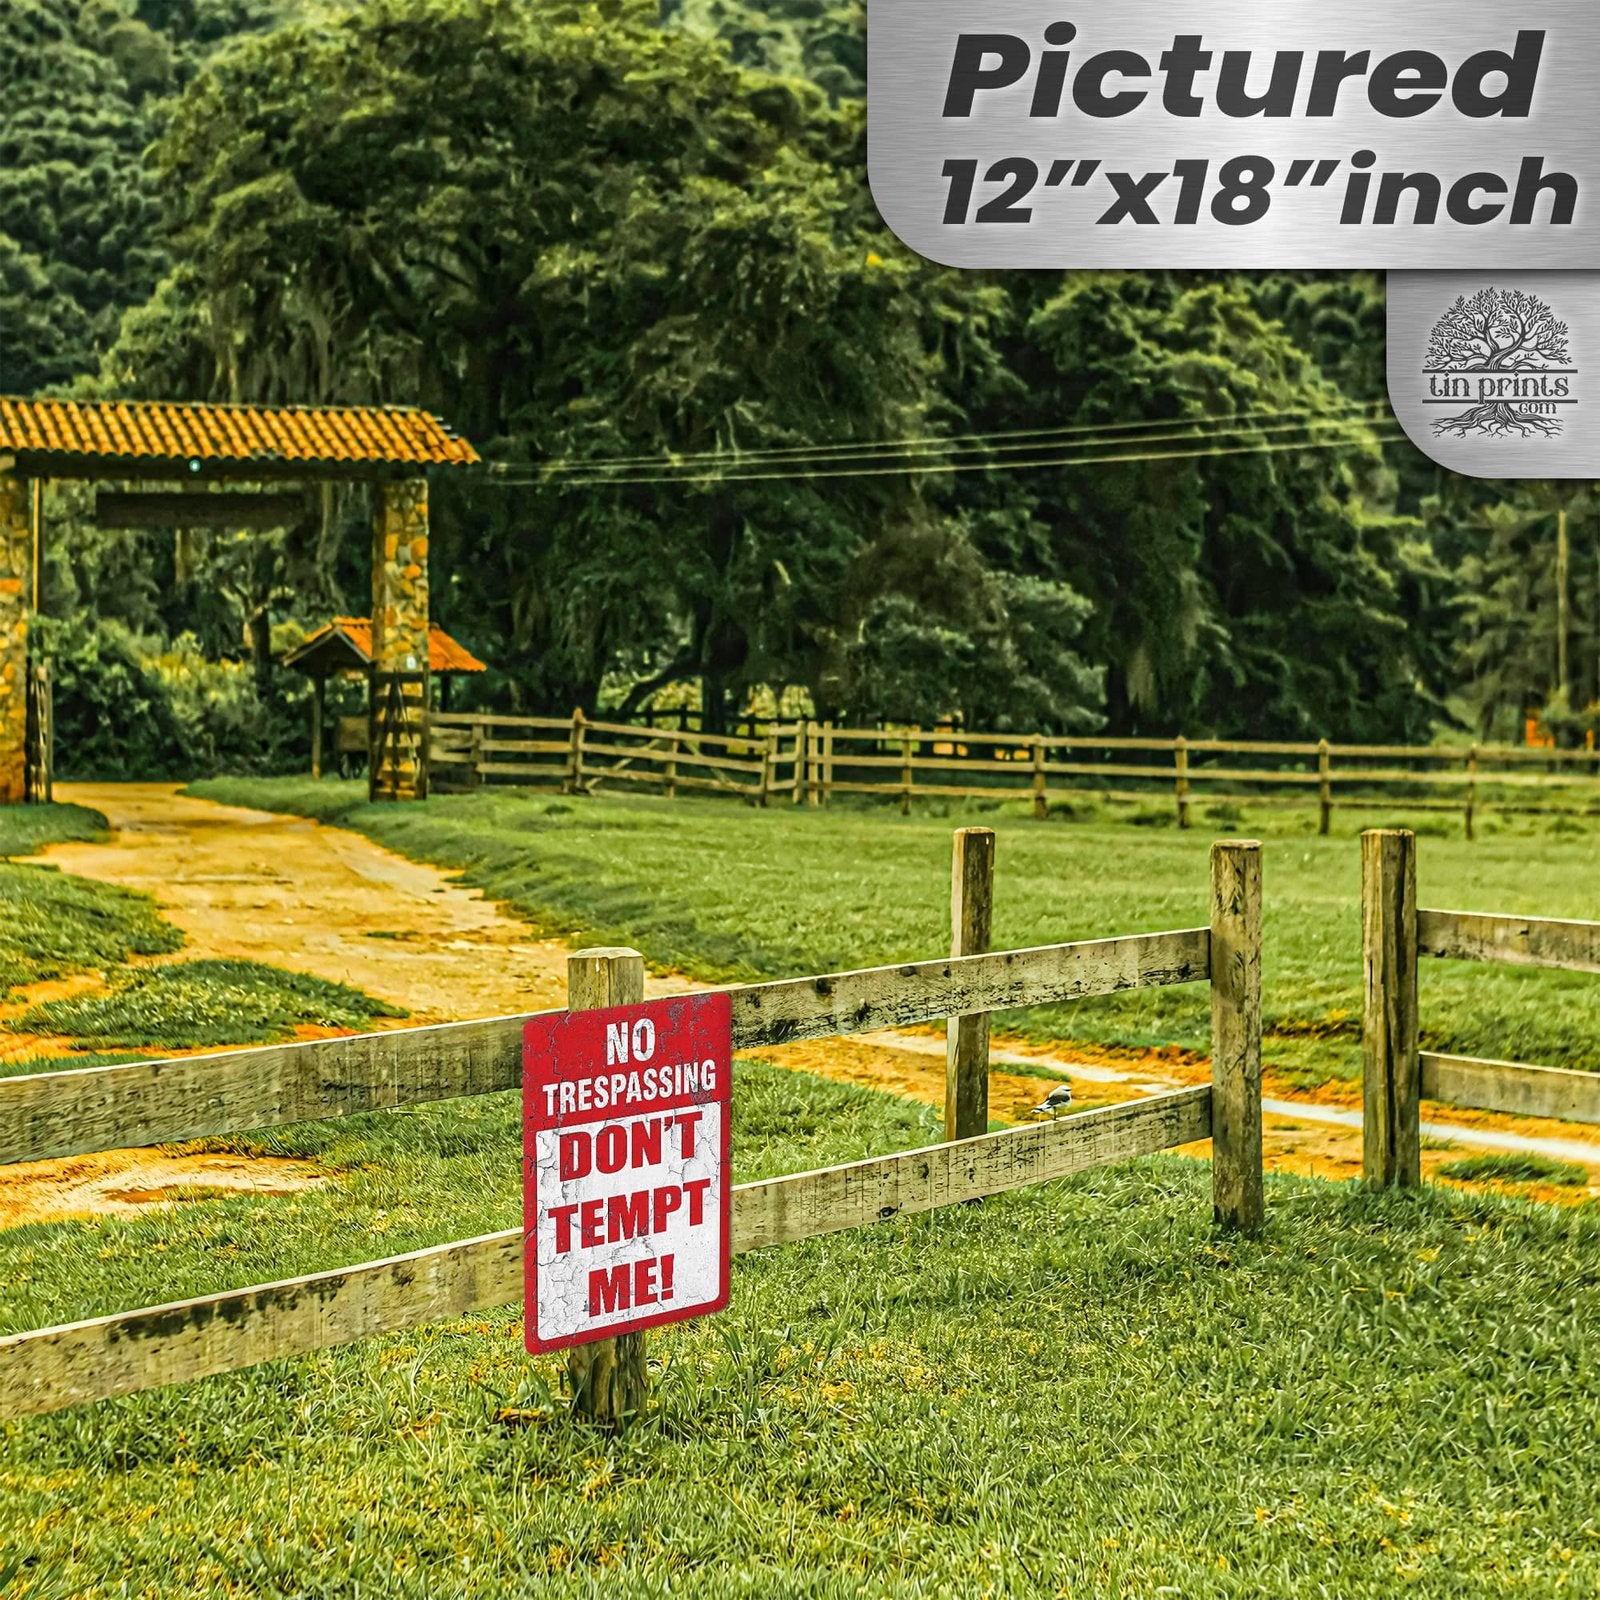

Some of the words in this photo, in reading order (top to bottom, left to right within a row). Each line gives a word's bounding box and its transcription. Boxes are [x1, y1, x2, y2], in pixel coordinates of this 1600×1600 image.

[606, 1018, 656, 1066] NO
[542, 1059, 717, 1117] TRESPASSING
[559, 1111, 703, 1182] DON'T
[548, 1178, 711, 1254] TEMPT
[588, 1254, 675, 1318] ME!
